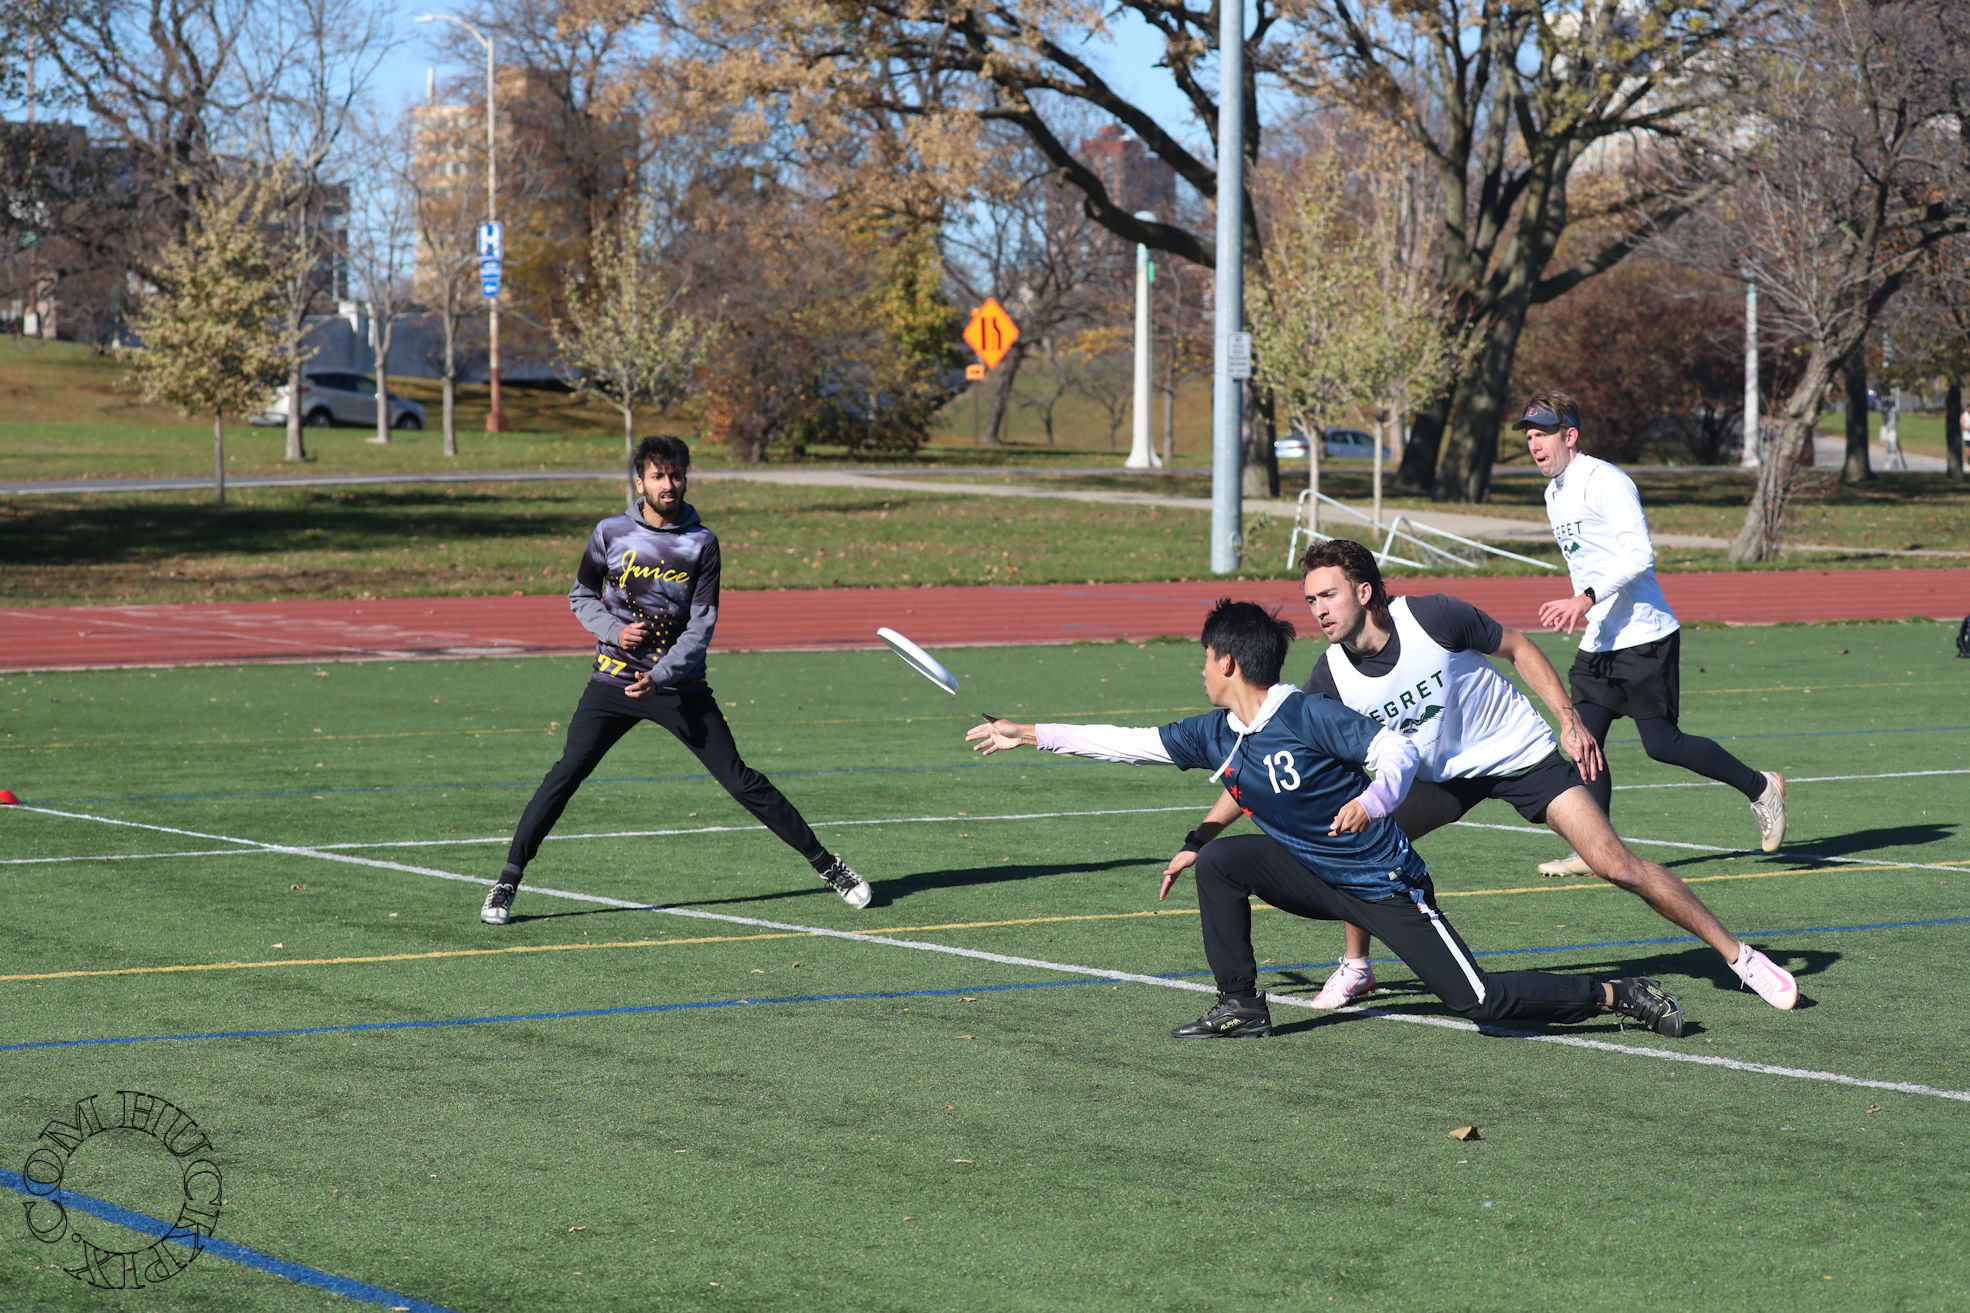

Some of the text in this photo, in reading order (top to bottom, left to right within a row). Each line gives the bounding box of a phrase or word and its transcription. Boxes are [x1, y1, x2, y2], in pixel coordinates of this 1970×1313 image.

[480, 225, 500, 256] H
[619, 549, 690, 589] Juice
[597, 654, 627, 677] 77
[1369, 670, 1443, 722] EGRET
[1263, 750, 1300, 794] 13
[1220, 1018, 1241, 1031] ALPHA
